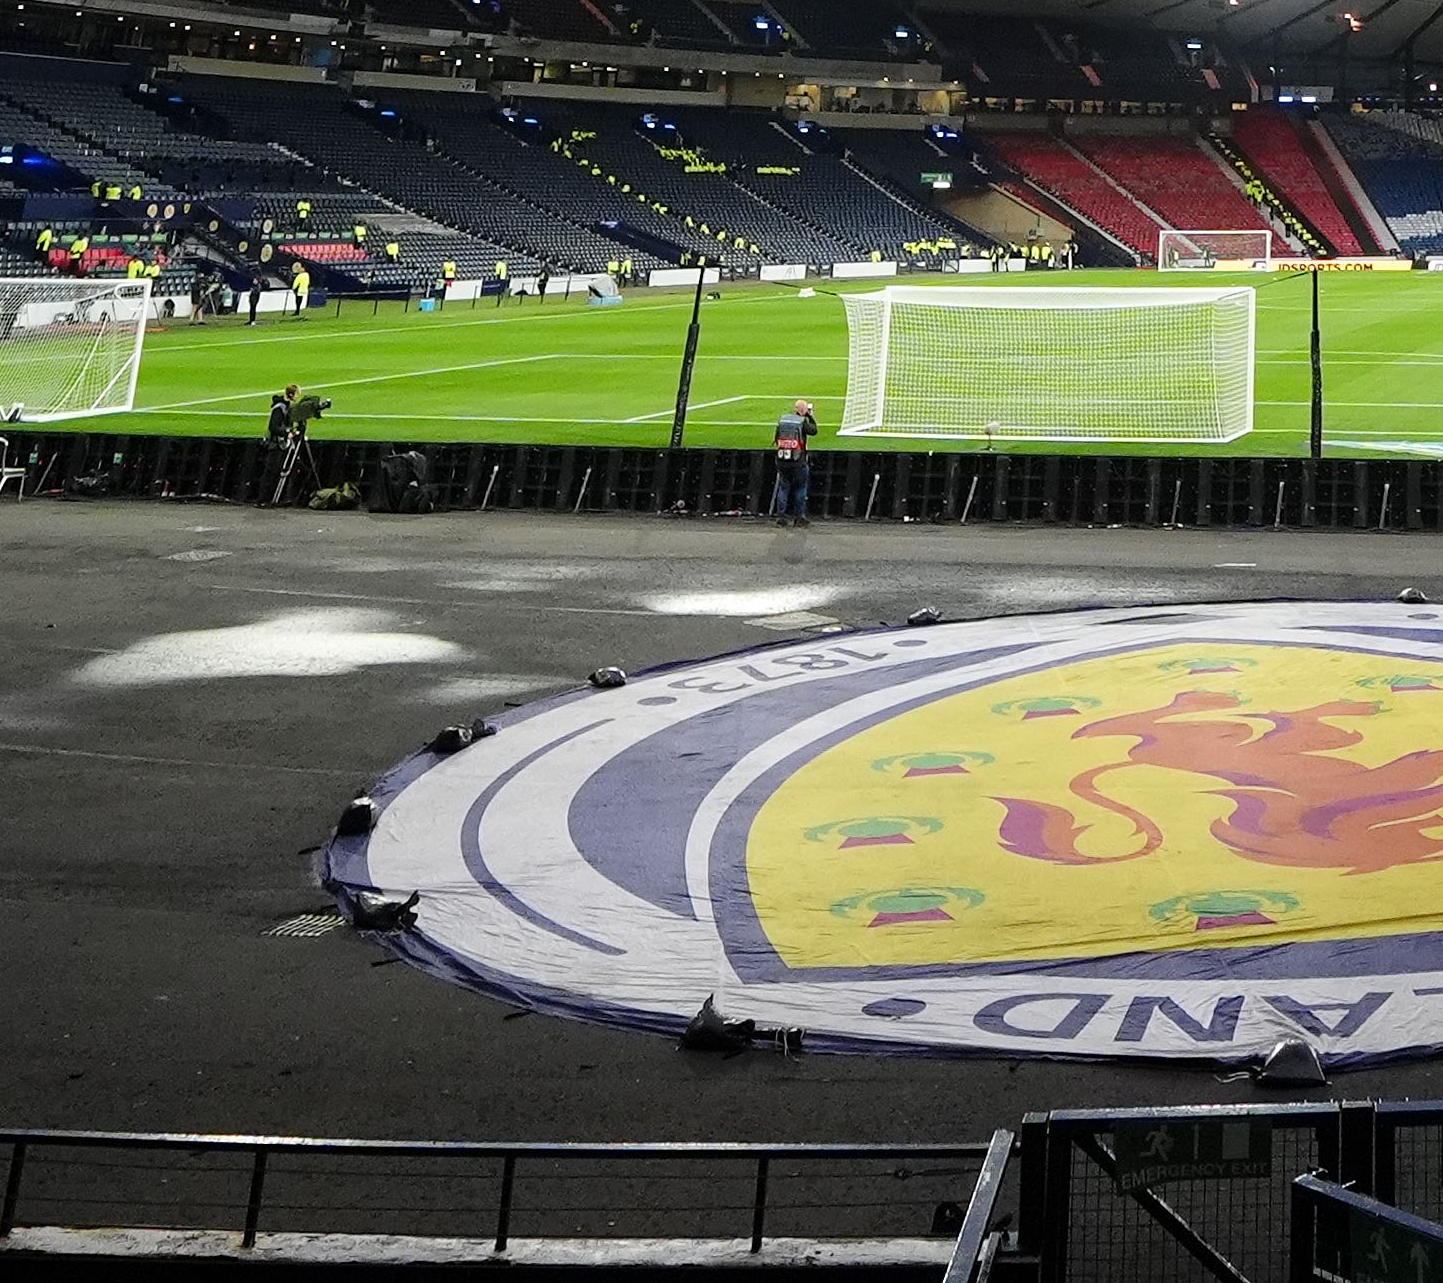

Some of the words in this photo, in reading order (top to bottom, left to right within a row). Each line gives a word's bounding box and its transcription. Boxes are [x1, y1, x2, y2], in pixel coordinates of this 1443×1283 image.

[667, 646, 888, 694] 1873
[1121, 1162, 1227, 1191] EMERGENCY
[1231, 1161, 1268, 1175] EXIT
